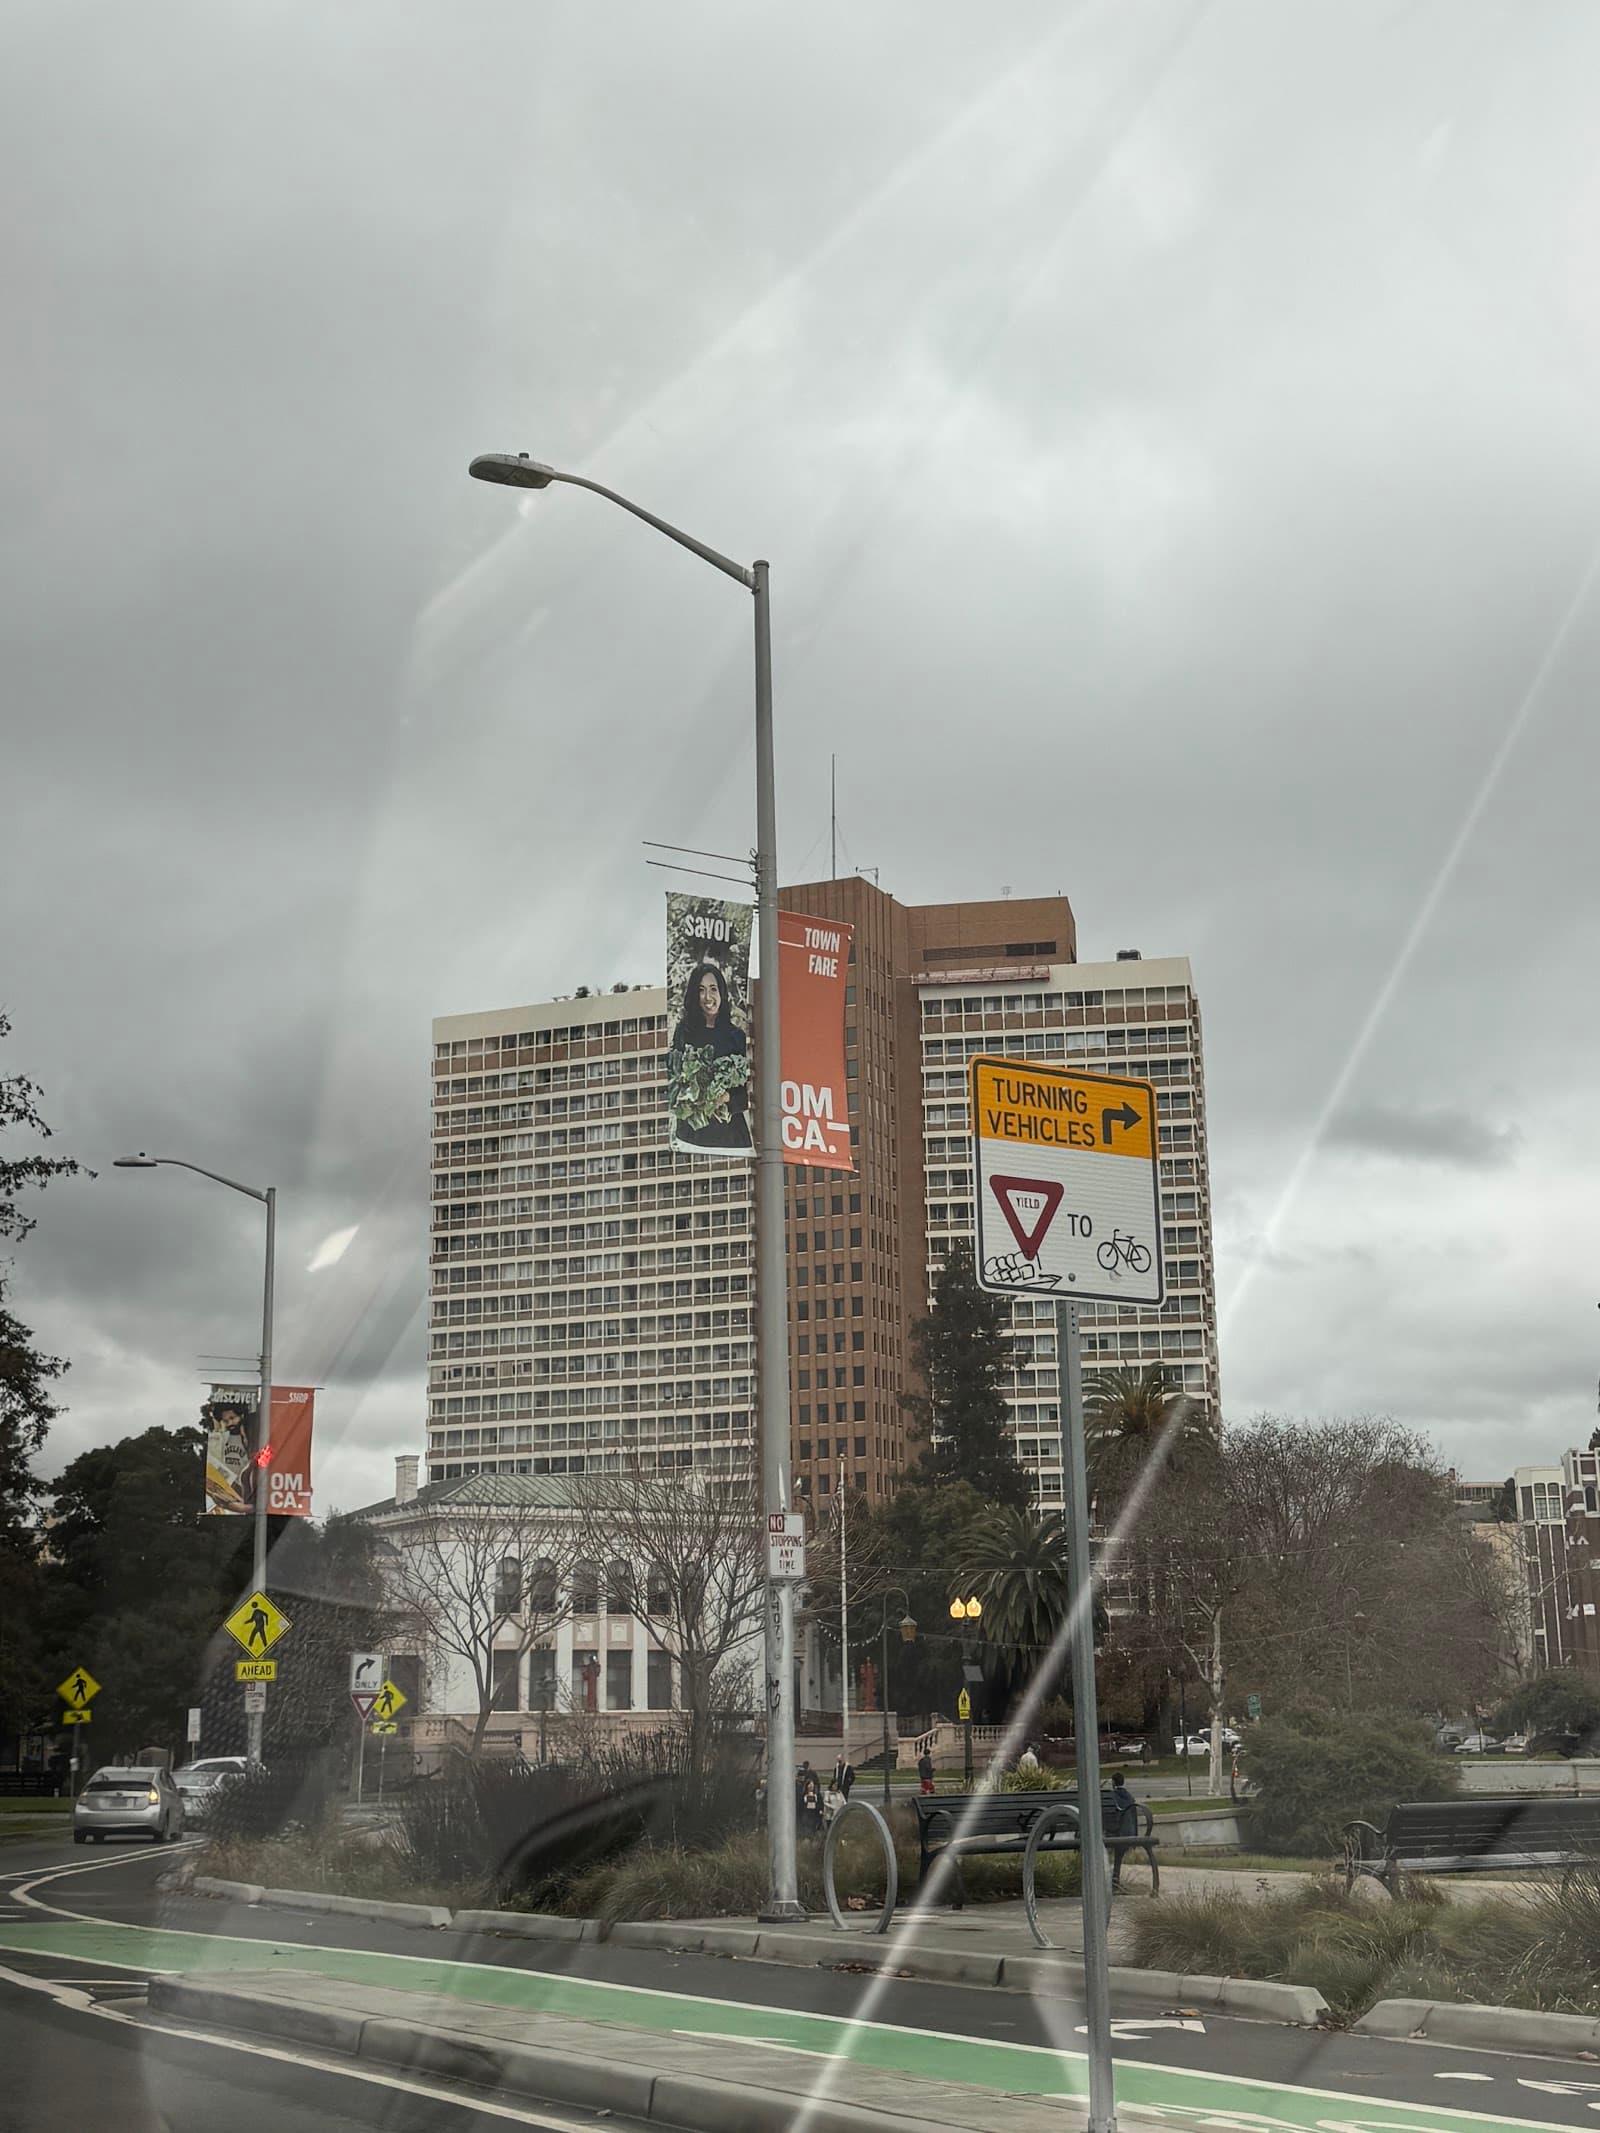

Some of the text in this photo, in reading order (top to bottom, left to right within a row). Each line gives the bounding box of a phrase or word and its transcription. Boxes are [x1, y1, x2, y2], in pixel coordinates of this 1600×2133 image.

[684, 914, 733, 943] savor
[805, 927, 840, 953] TOWN
[808, 954, 838, 978] FARE
[781, 1080, 833, 1120] OM
[992, 1077, 1087, 1114] TURNING
[987, 1109, 1095, 1147] VEHICLES
[1016, 1197, 1040, 1209] YIELD
[1067, 1213, 1093, 1238] TO
[271, 1474, 303, 1490] OM
[770, 1515, 784, 1531] NO
[779, 1549, 794, 1558] ANY
[779, 1559, 795, 1570] TIME
[241, 1665, 272, 1677] AHEAD
[354, 1681, 378, 1689] ONLY
